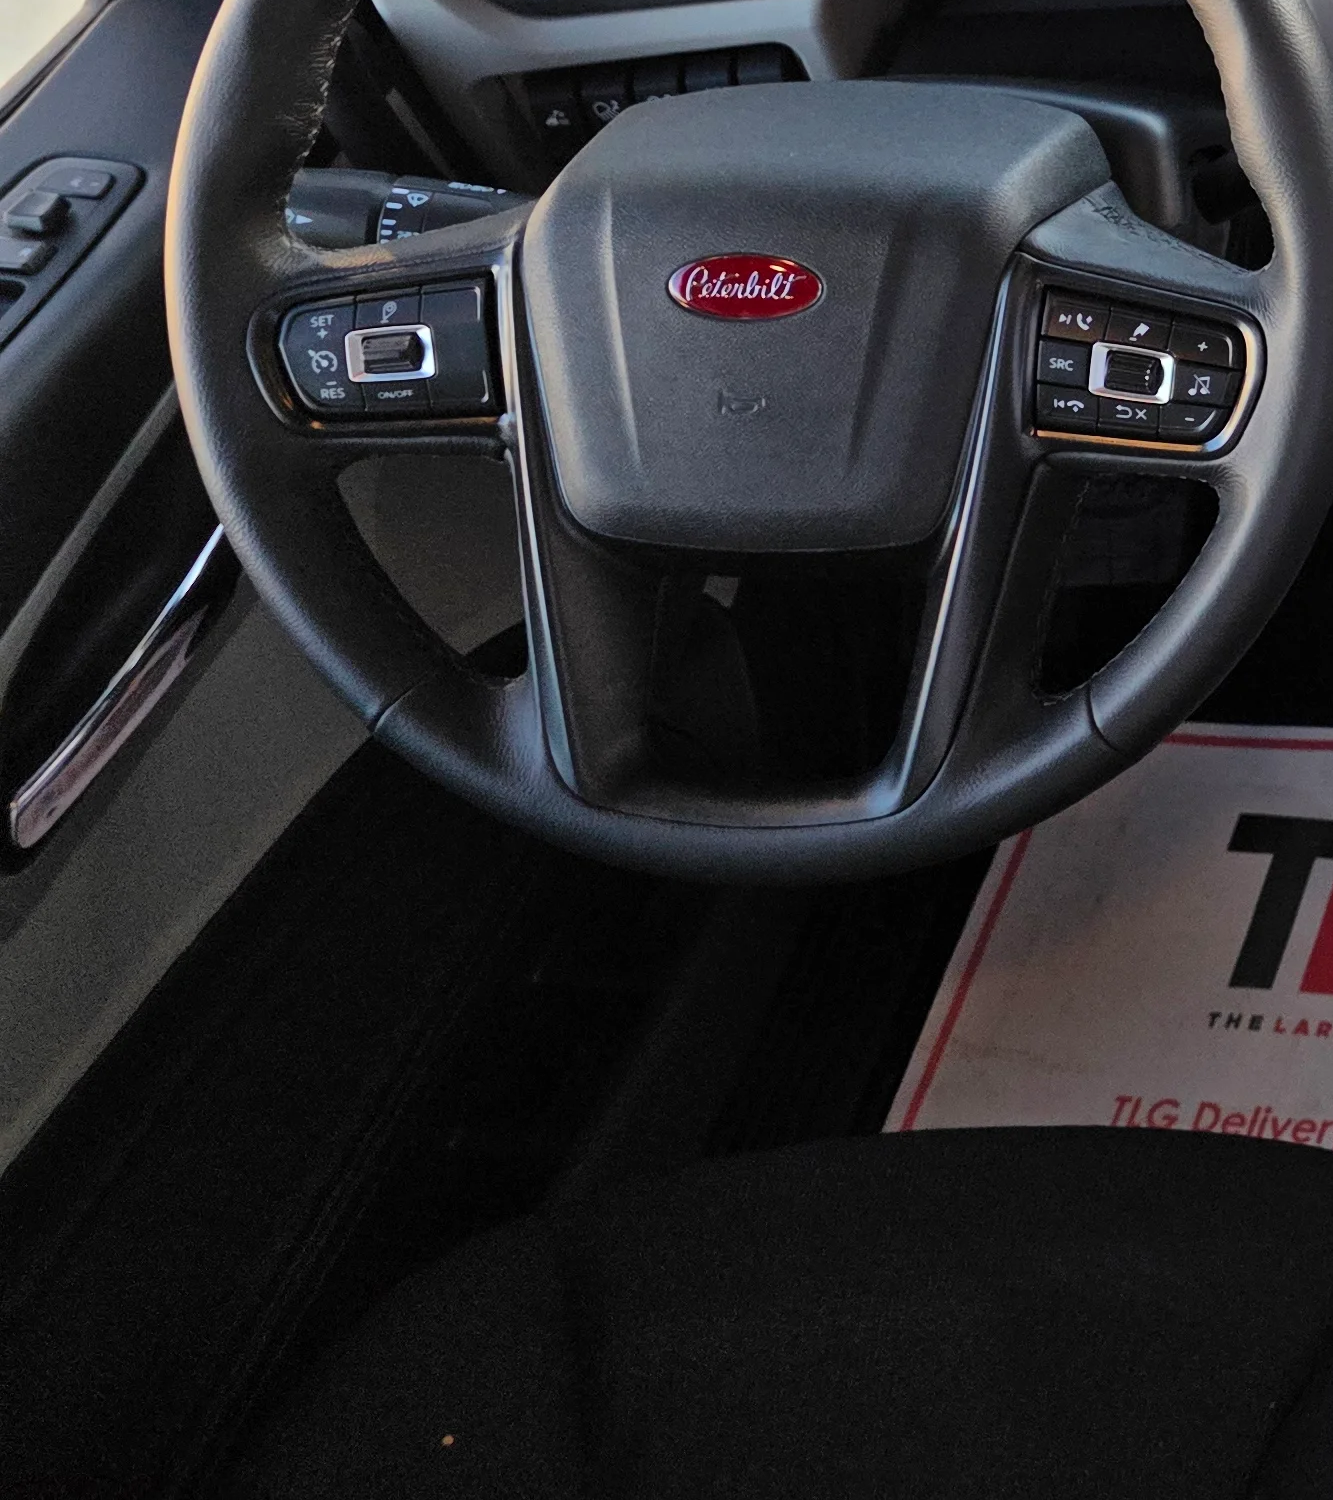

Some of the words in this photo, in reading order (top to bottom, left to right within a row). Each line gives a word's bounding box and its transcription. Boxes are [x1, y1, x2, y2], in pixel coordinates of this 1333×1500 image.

[685, 265, 807, 301] Peterbilt
[310, 314, 335, 328] SET
[1049, 357, 1075, 372] SRC
[320, 387, 346, 400] RES
[377, 389, 414, 399] ON/OFF
[1207, 1011, 1265, 1032] THE
[1112, 1094, 1181, 1129] TLG
